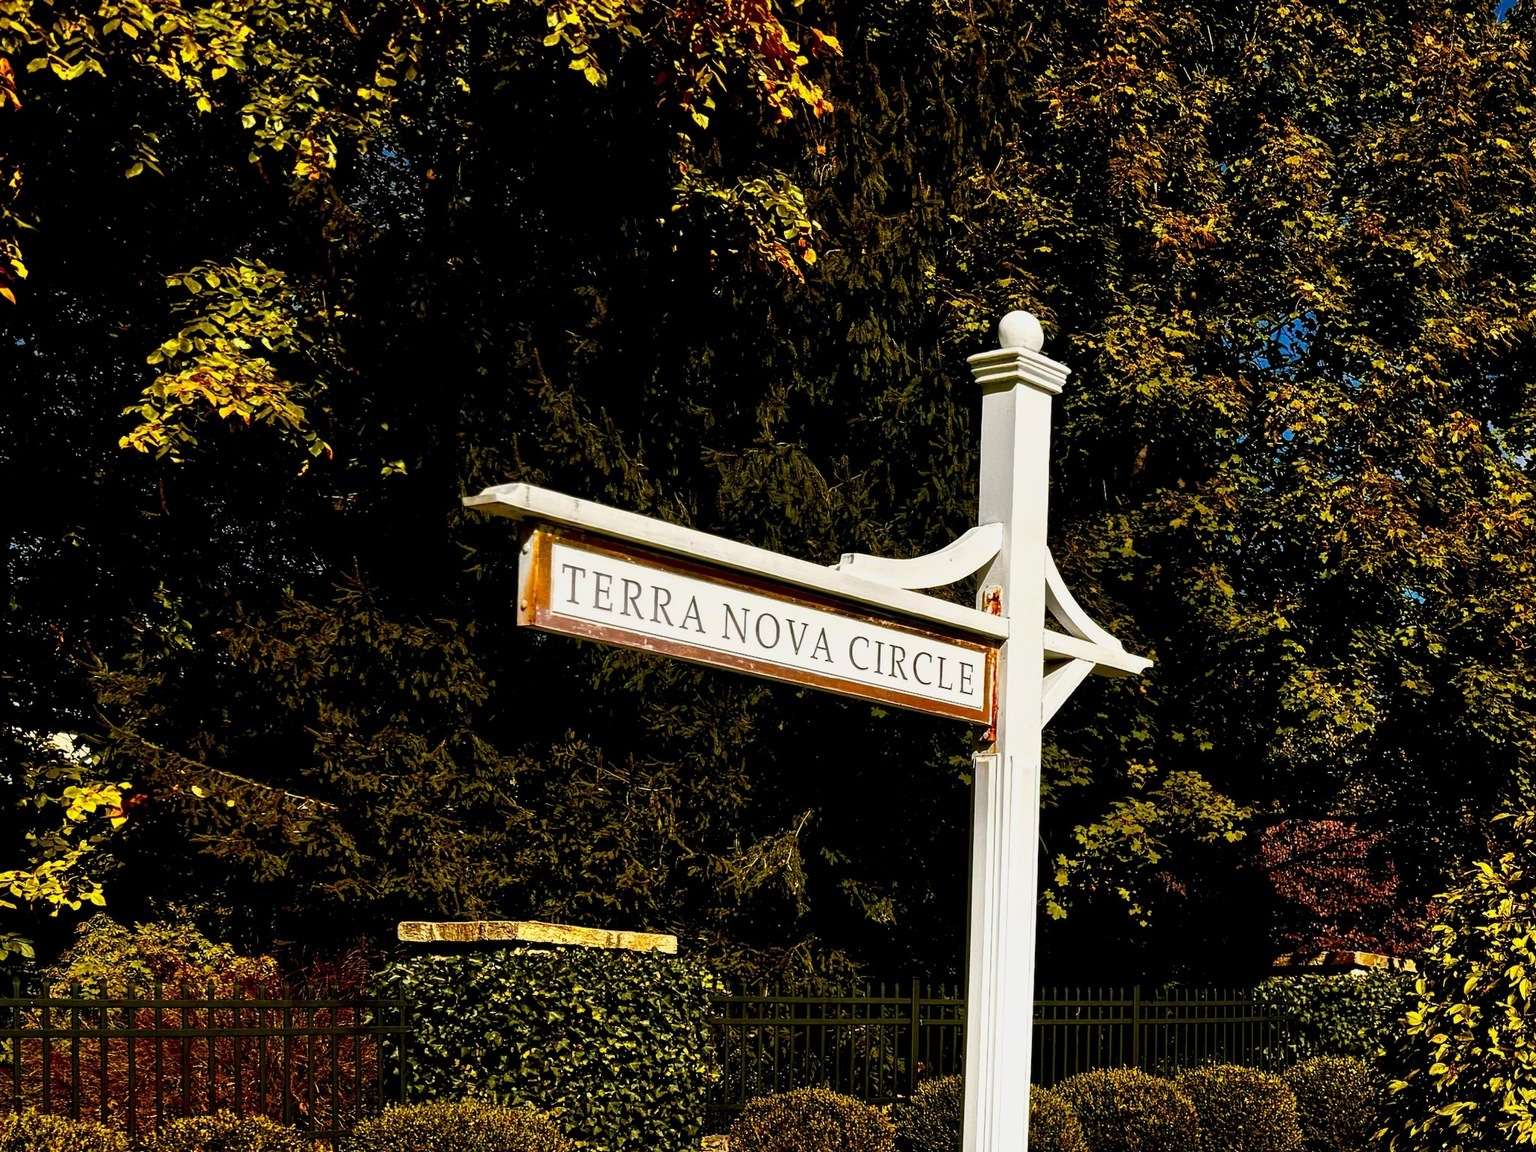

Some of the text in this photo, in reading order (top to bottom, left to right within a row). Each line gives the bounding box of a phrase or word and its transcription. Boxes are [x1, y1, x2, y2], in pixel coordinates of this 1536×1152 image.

[562, 563, 976, 696] TERRA NOVA CIRCLE
